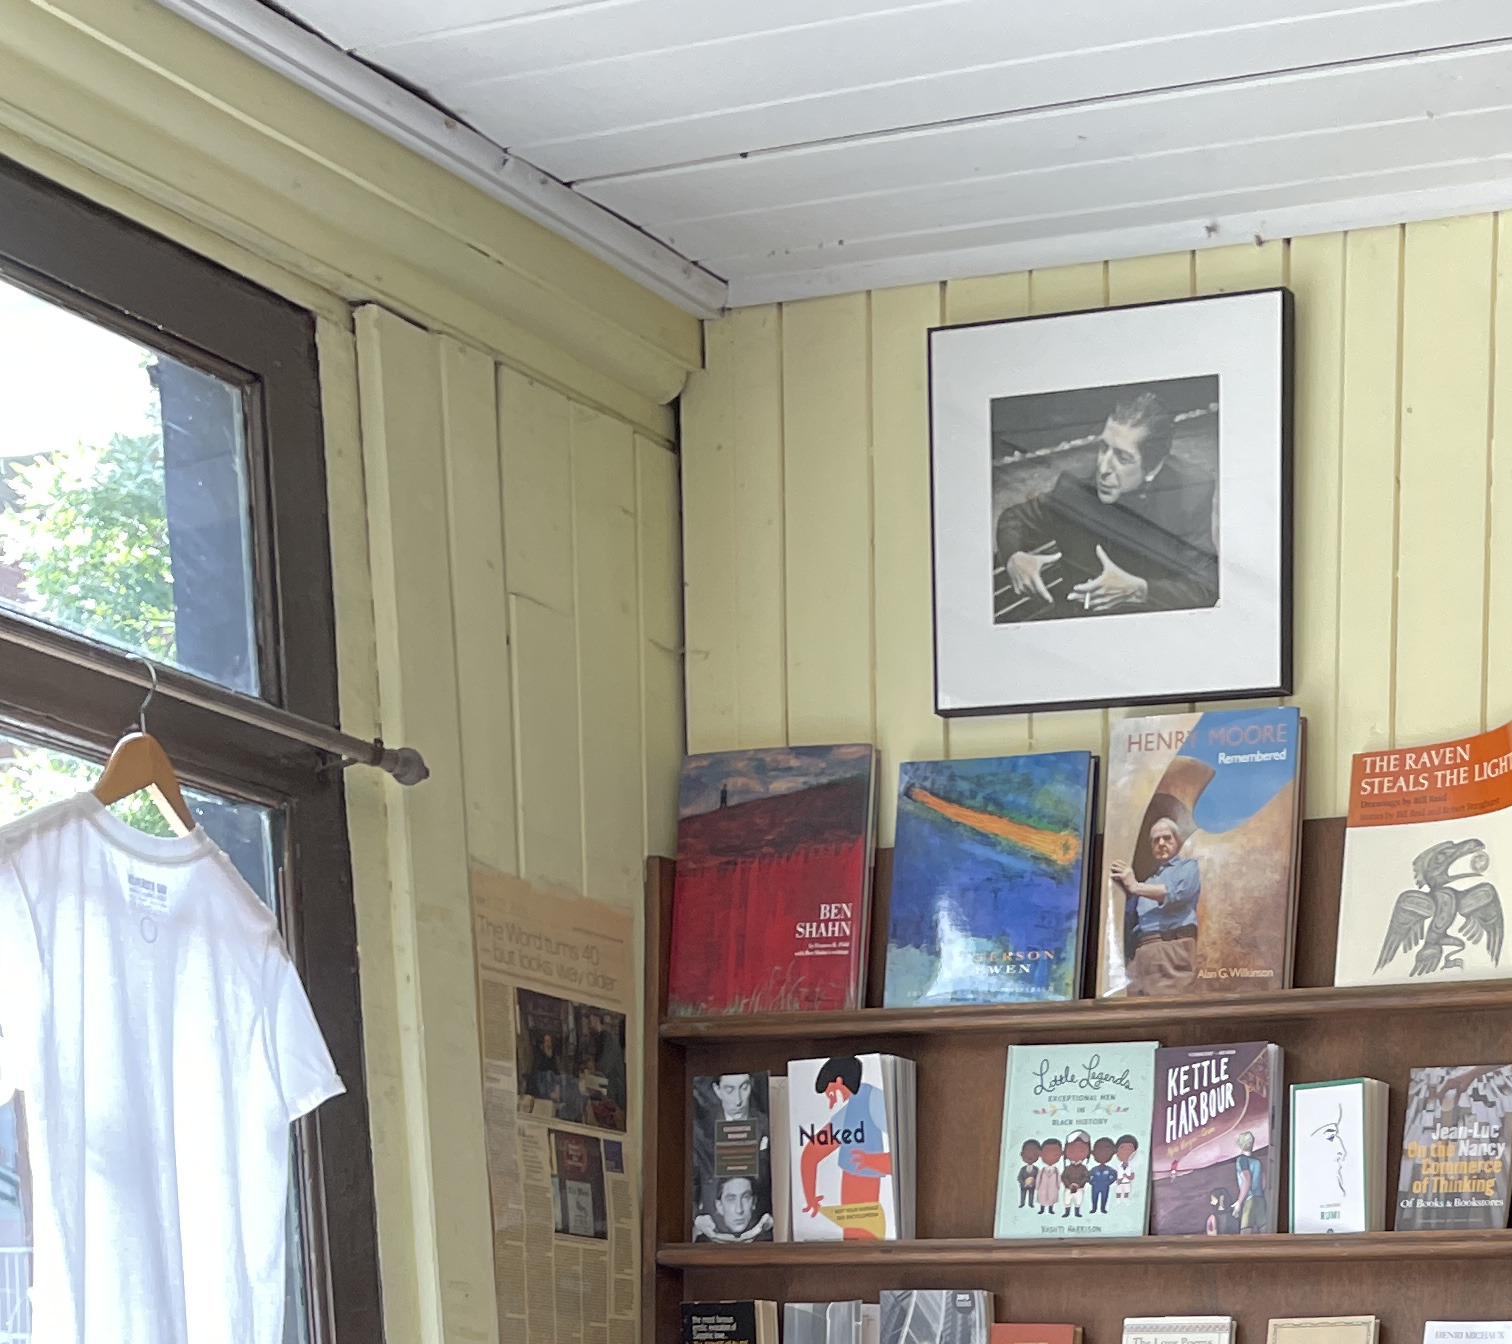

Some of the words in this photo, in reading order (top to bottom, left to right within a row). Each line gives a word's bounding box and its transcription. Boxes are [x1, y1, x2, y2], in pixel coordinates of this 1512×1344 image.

[1128, 731, 1199, 753] HENRY
[1208, 723, 1287, 746] MOORE
[1218, 749, 1287, 764] Remembered
[1364, 754, 1401, 774] THE
[1405, 744, 1471, 769] RAVEN
[1360, 773, 1428, 796] STEALS
[1434, 769, 1469, 788] THE
[819, 903, 853, 921] BEN
[795, 921, 851, 939] SHAHN
[1033, 1058, 1078, 1095] Little
[1079, 1053, 1134, 1092] Legends
[1167, 1057, 1229, 1104] KETTLE
[1165, 1082, 1235, 1143] HARBOUR
[799, 1122, 866, 1147] Naked
[1431, 1122, 1499, 1141] Jean-Luc
[1457, 1139, 1505, 1162] Nancy
[1422, 1157, 1502, 1177] Commerce
[1412, 1176, 1428, 1194] of
[1430, 1175, 1496, 1198] Thinking
